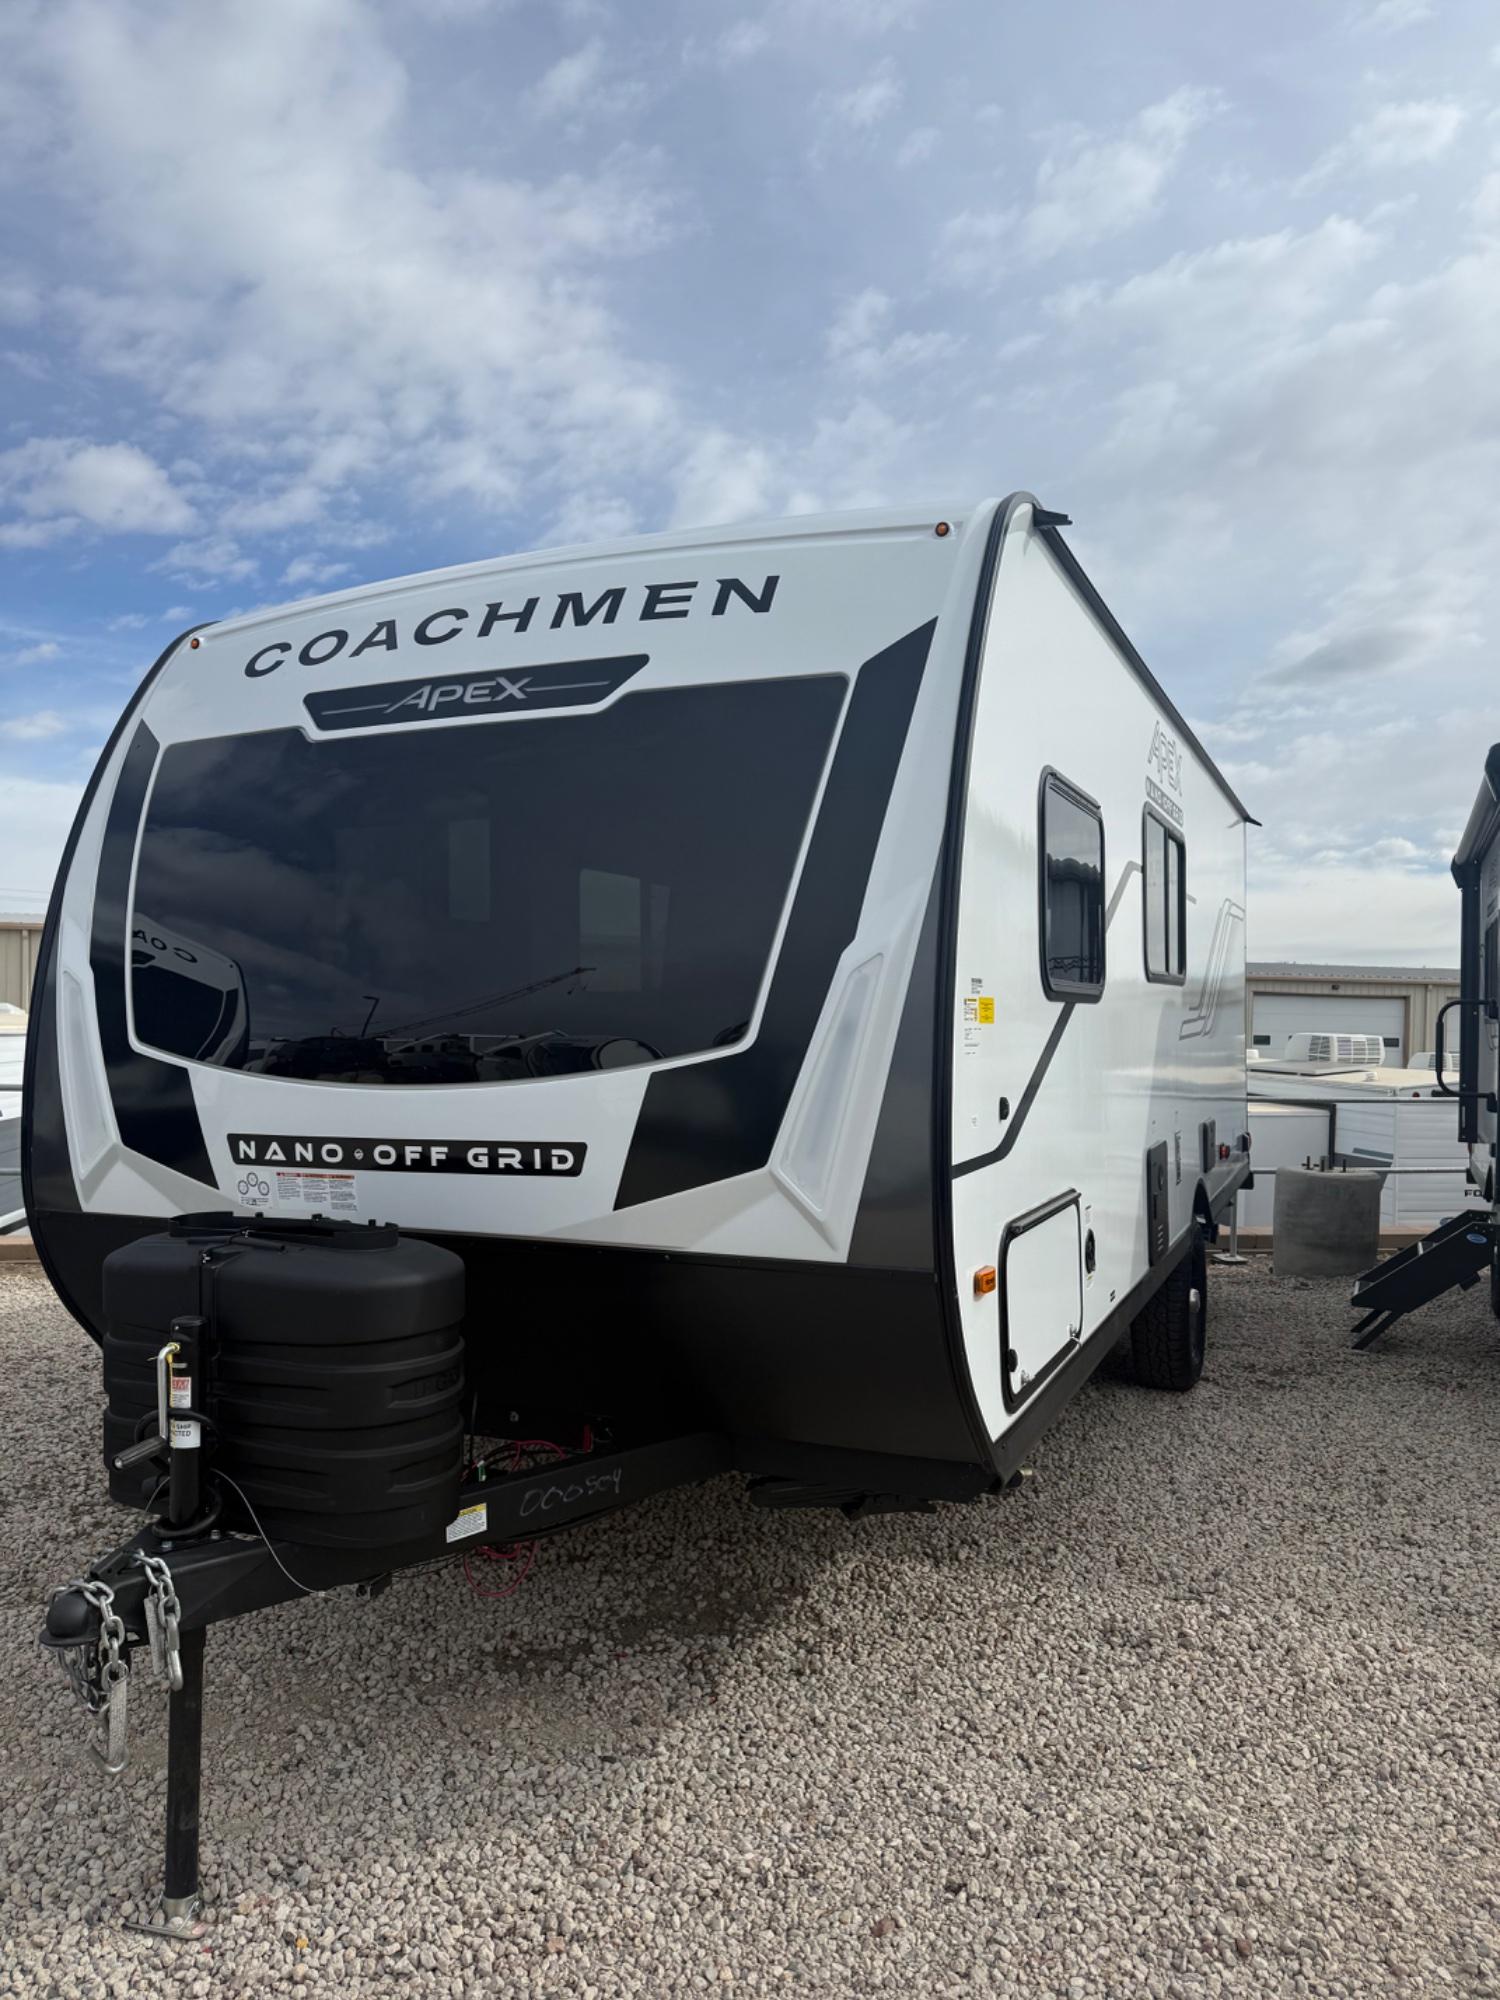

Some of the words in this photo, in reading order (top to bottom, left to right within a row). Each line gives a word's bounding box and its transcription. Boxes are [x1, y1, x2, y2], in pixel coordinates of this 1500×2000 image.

[243, 574, 780, 678] COACHMEN
[384, 676, 534, 713] APEX
[238, 1139, 344, 1164] NANO
[372, 1143, 449, 1167] OFF
[466, 1146, 576, 1171] GRID
